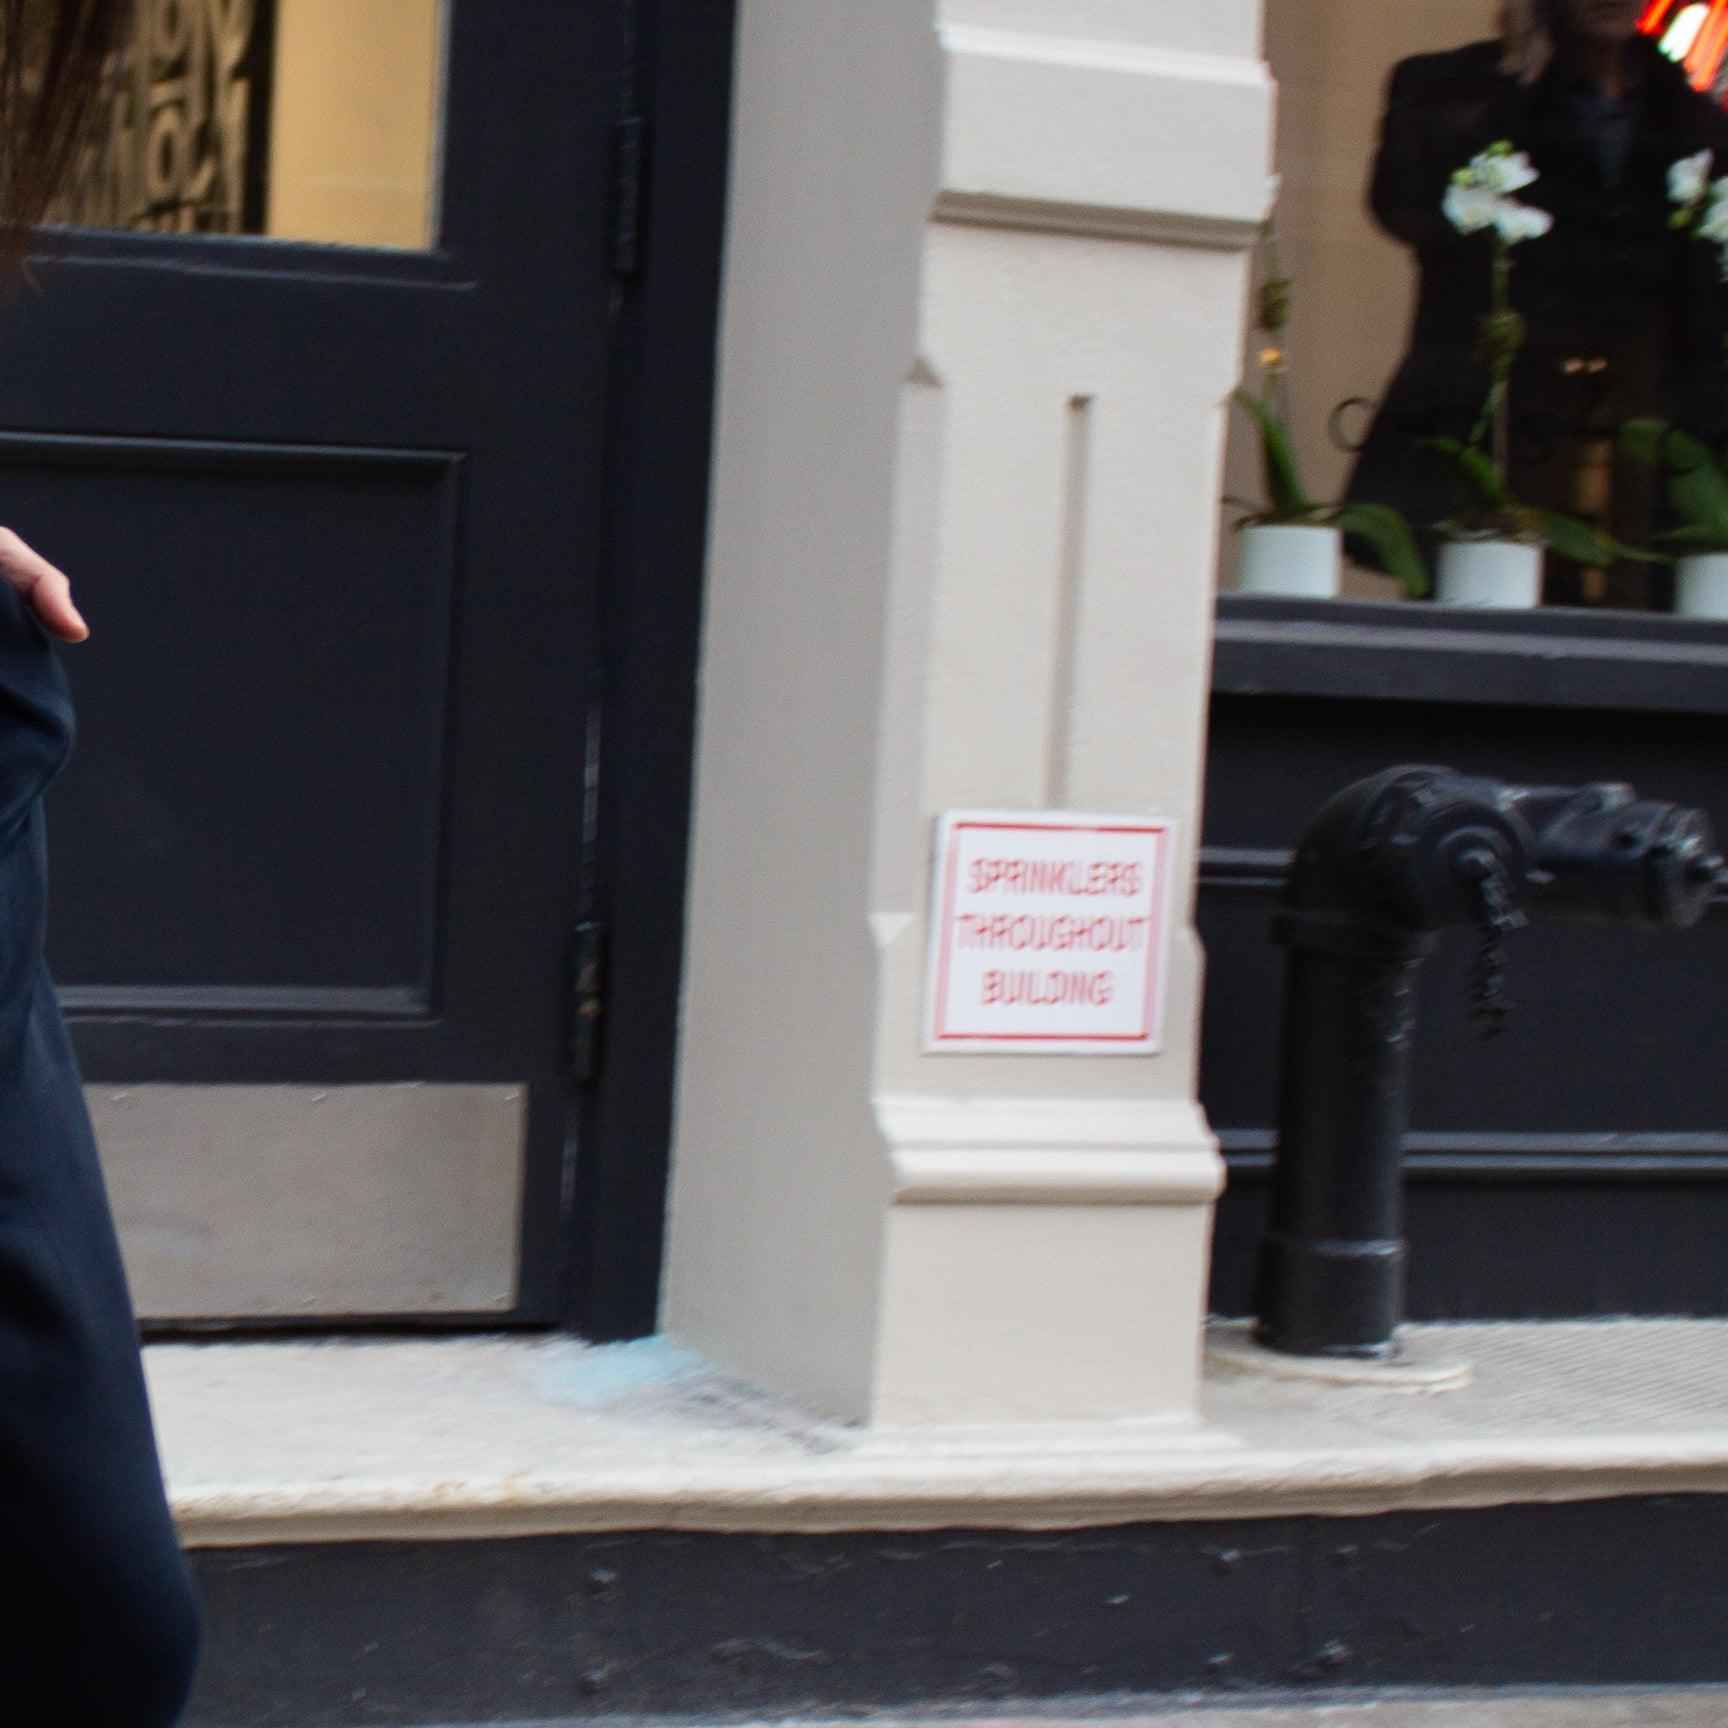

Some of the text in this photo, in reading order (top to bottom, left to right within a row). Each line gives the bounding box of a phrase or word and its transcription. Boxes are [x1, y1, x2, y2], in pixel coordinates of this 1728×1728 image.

[971, 858, 1140, 896] SPRINKLERS
[959, 913, 1149, 951] THROUGHOUT
[982, 970, 1113, 1006] BUILDING
